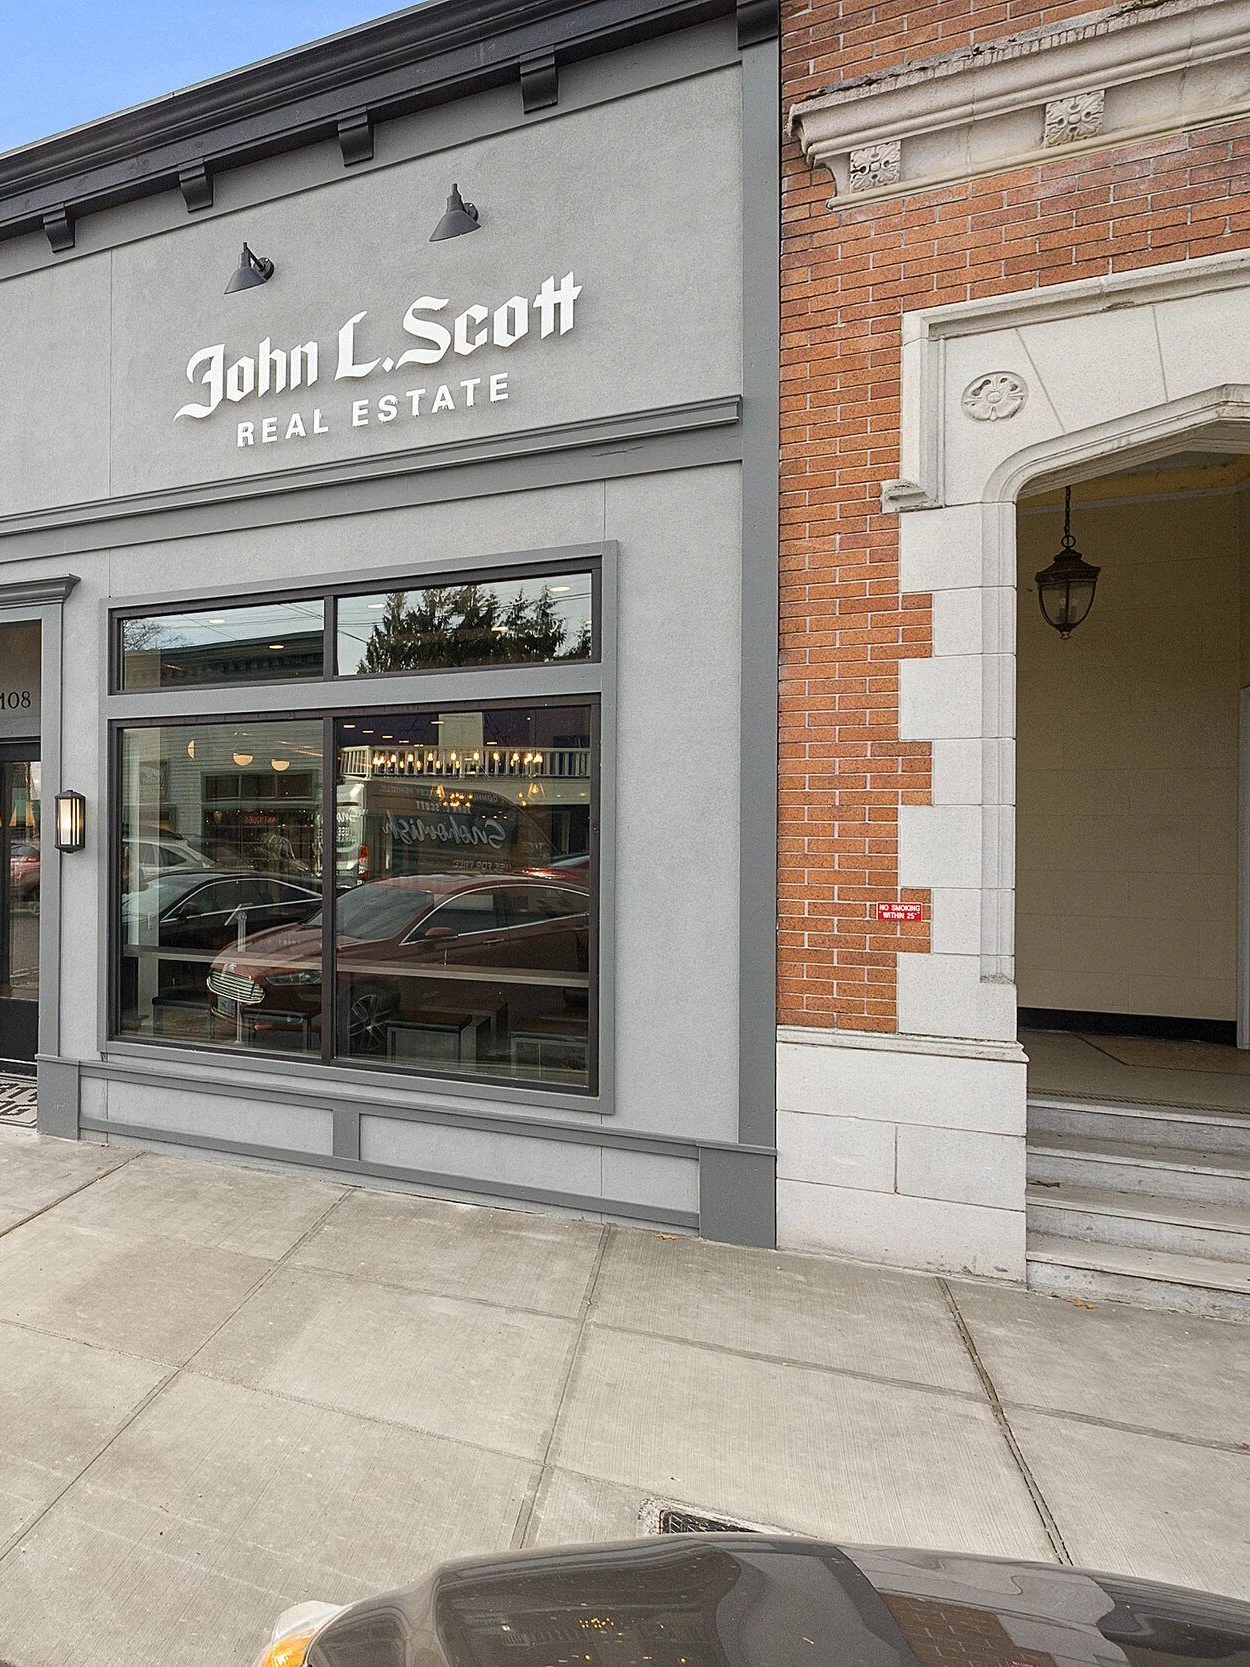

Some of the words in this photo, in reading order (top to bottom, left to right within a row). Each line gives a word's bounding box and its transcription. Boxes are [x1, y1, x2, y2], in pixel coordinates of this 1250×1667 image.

[173, 336, 318, 421] John
[334, 310, 394, 381] L.
[395, 271, 583, 370] Scott
[237, 408, 329, 448] REAL
[352, 372, 509, 427] ESTATE
[0, 690, 31, 710] 108
[891, 904, 921, 912] SMOKING
